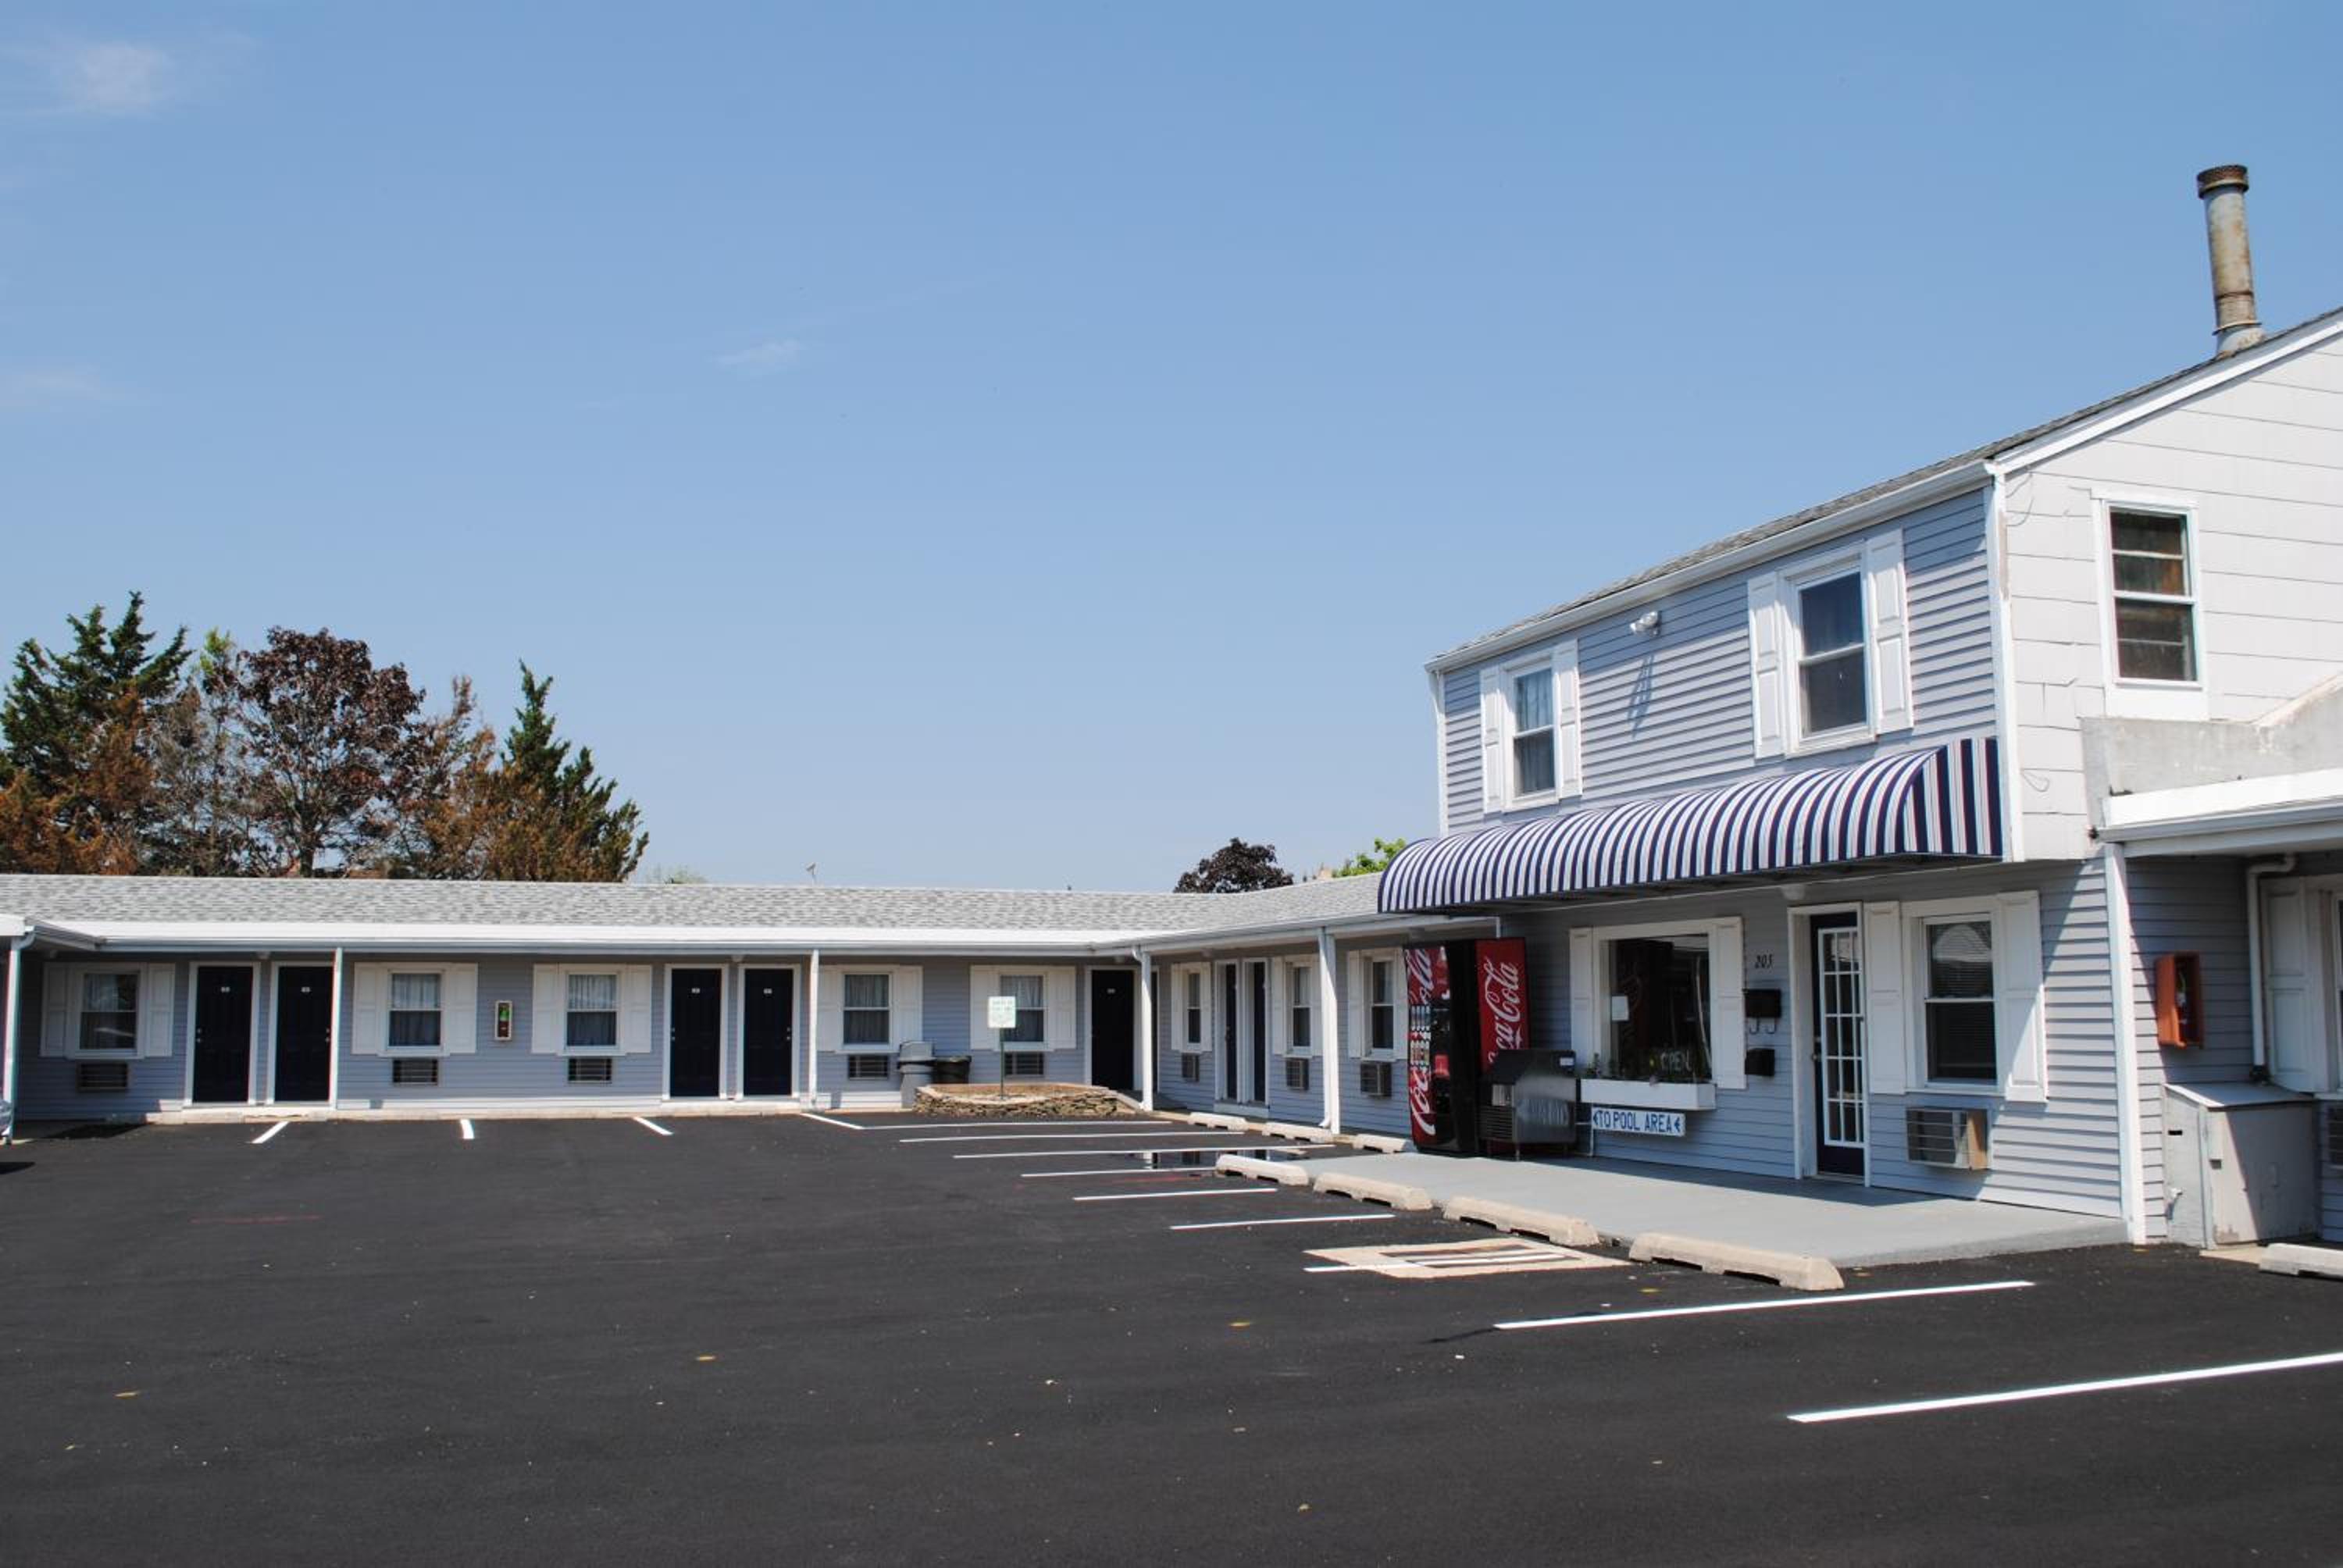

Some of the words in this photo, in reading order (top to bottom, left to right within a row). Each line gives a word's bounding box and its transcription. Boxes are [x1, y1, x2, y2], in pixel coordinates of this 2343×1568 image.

[1598, 1110, 1611, 1128] TO
[1613, 1111, 1640, 1131] POOL
[1644, 1112, 1672, 1132] AREA
